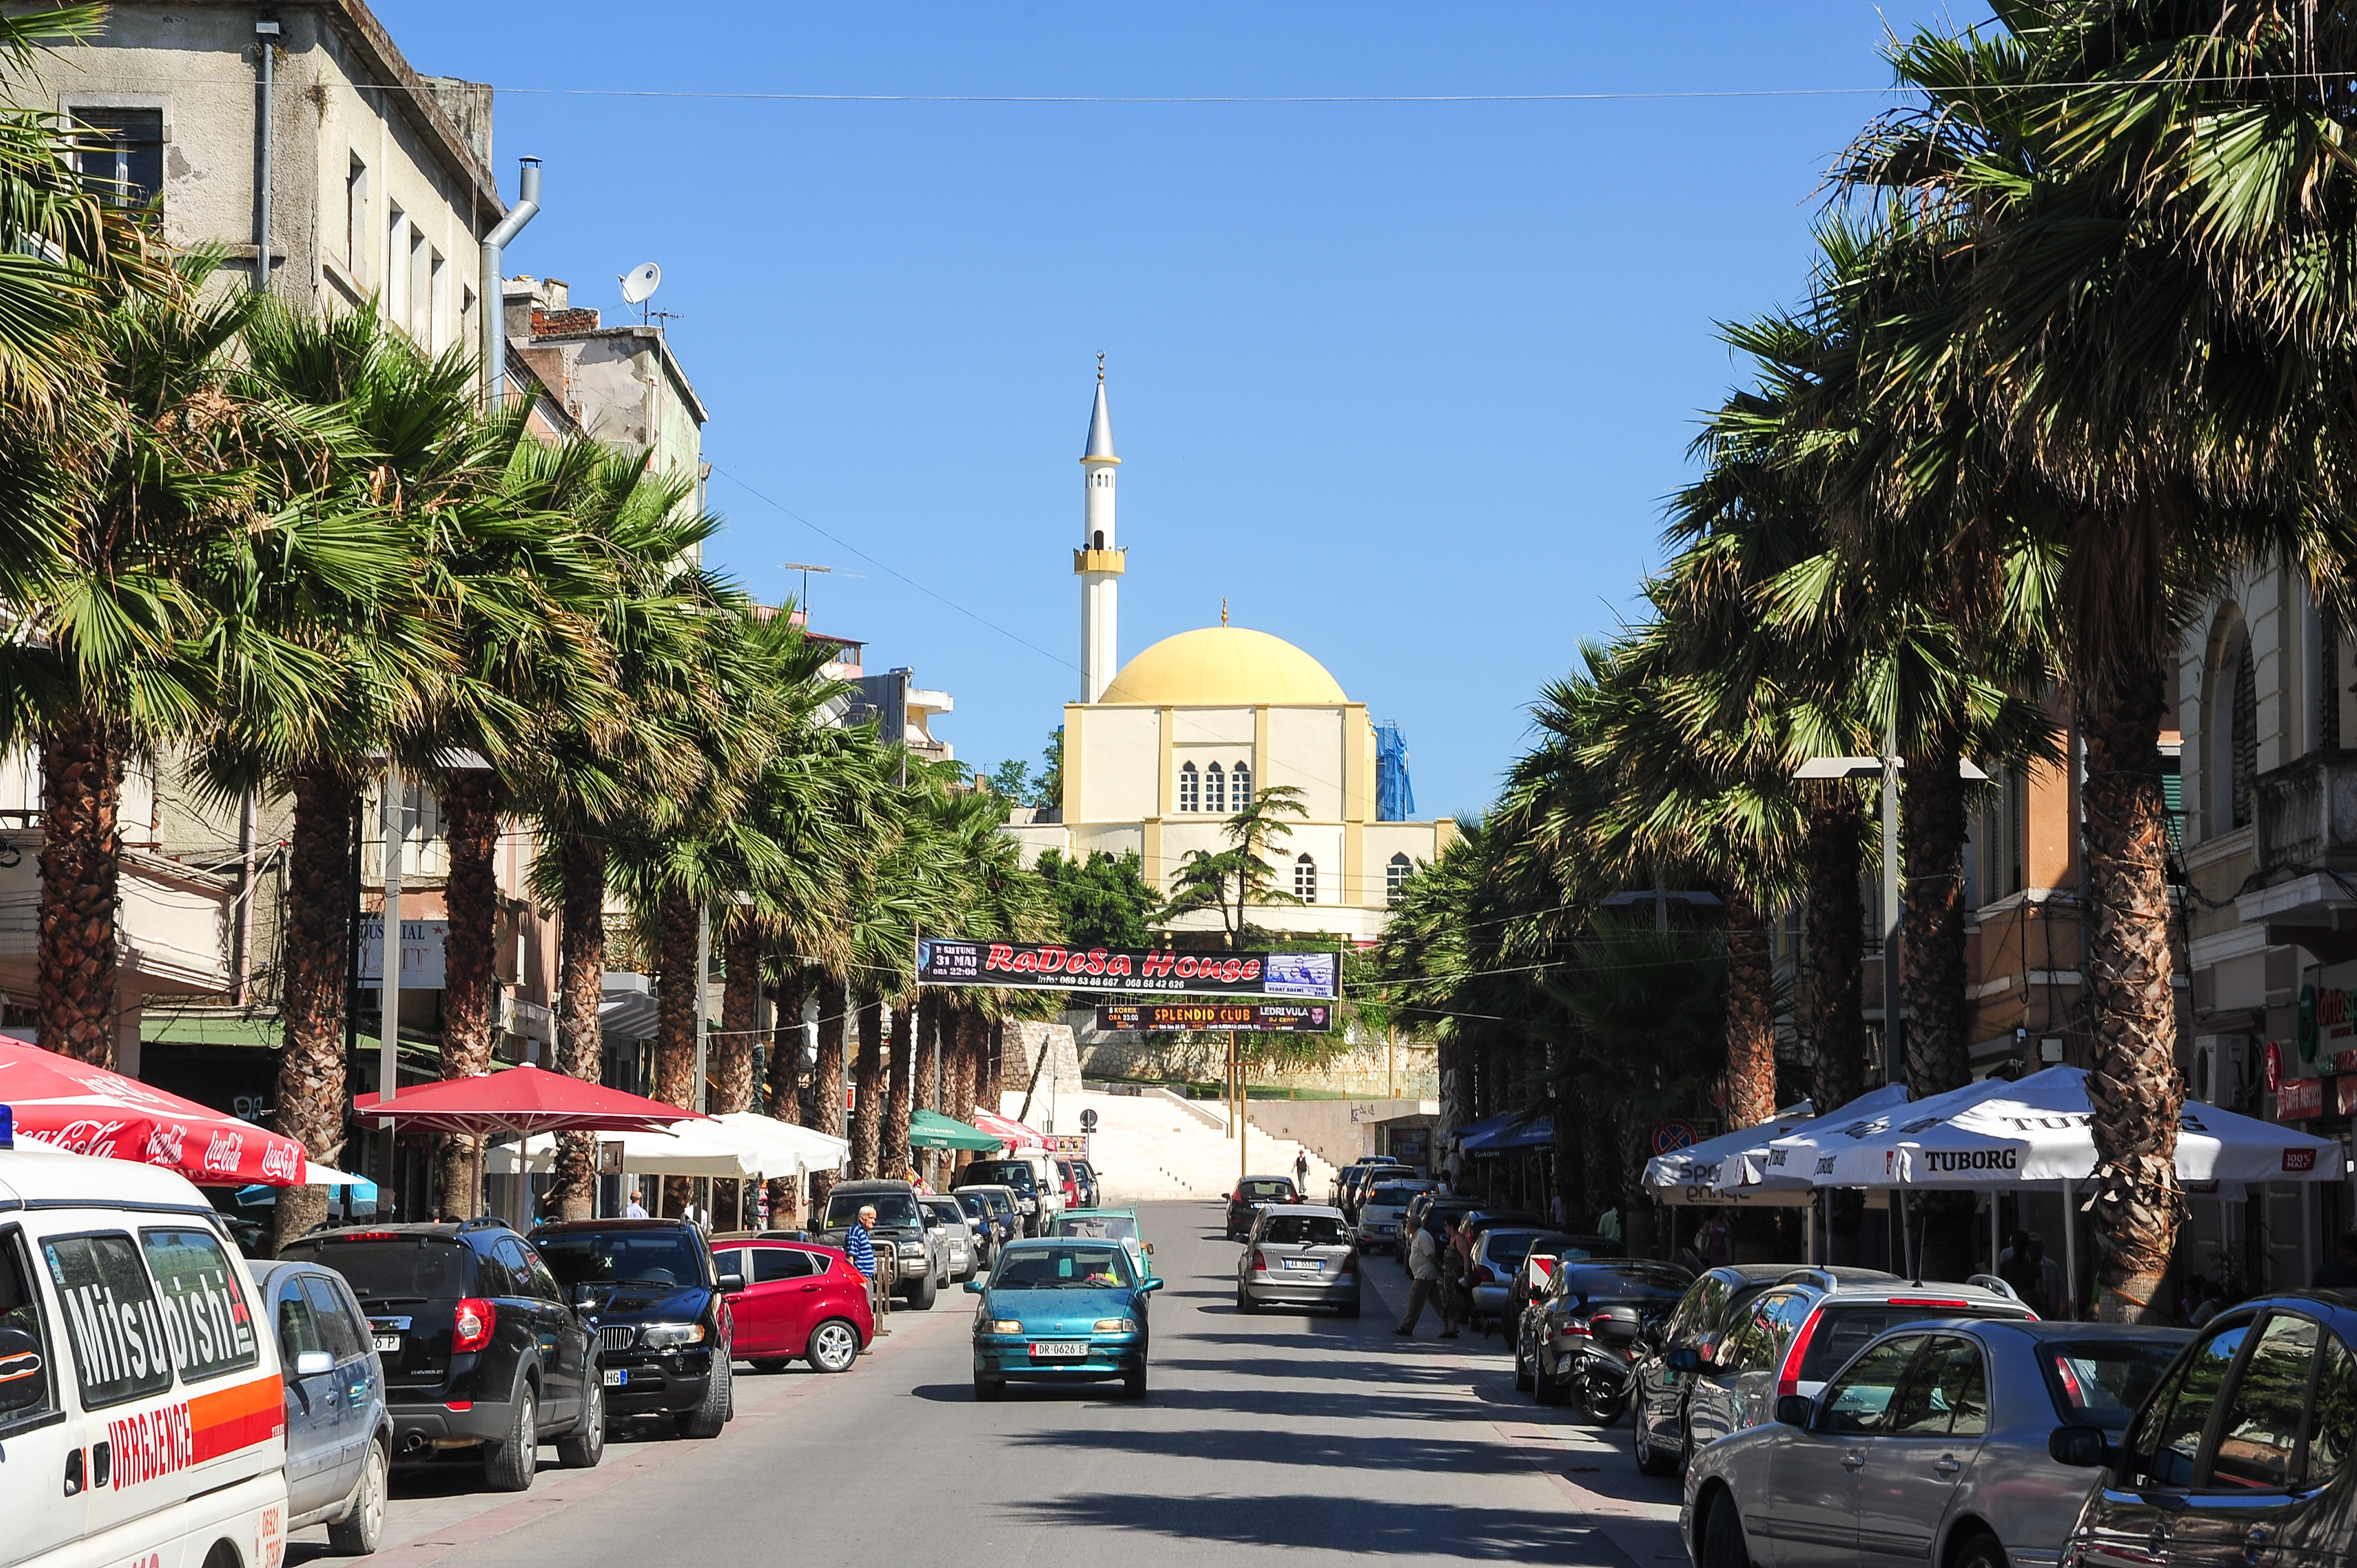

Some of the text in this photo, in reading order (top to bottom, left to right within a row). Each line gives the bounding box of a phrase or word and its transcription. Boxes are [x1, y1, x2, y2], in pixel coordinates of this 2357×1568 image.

[936, 955, 977, 967] 31 MAJ
[985, 943, 1261, 983] RaDeSa House
[950, 968, 977, 976] 22:00
[1037, 975, 1058, 984] Info:
[1059, 976, 1075, 985] 069
[1103, 978, 1119, 987] 667
[1125, 979, 1141, 988] 068
[1143, 979, 1154, 988] 68
[1155, 980, 1166, 988] 42
[1168, 981, 1185, 989] 626
[1155, 1009, 1250, 1021] SPLENDID CLUB
[204, 1129, 244, 1172] Coca-Cola
[262, 1139, 300, 1182] Coca-Cola
[1926, 1148, 2016, 1172] TUBORG
[2287, 1154, 2311, 1163] 100%
[388, 1336, 395, 1348] P
[606, 1372, 619, 1383] HG
[108, 1402, 193, 1492] URRGJENCE
